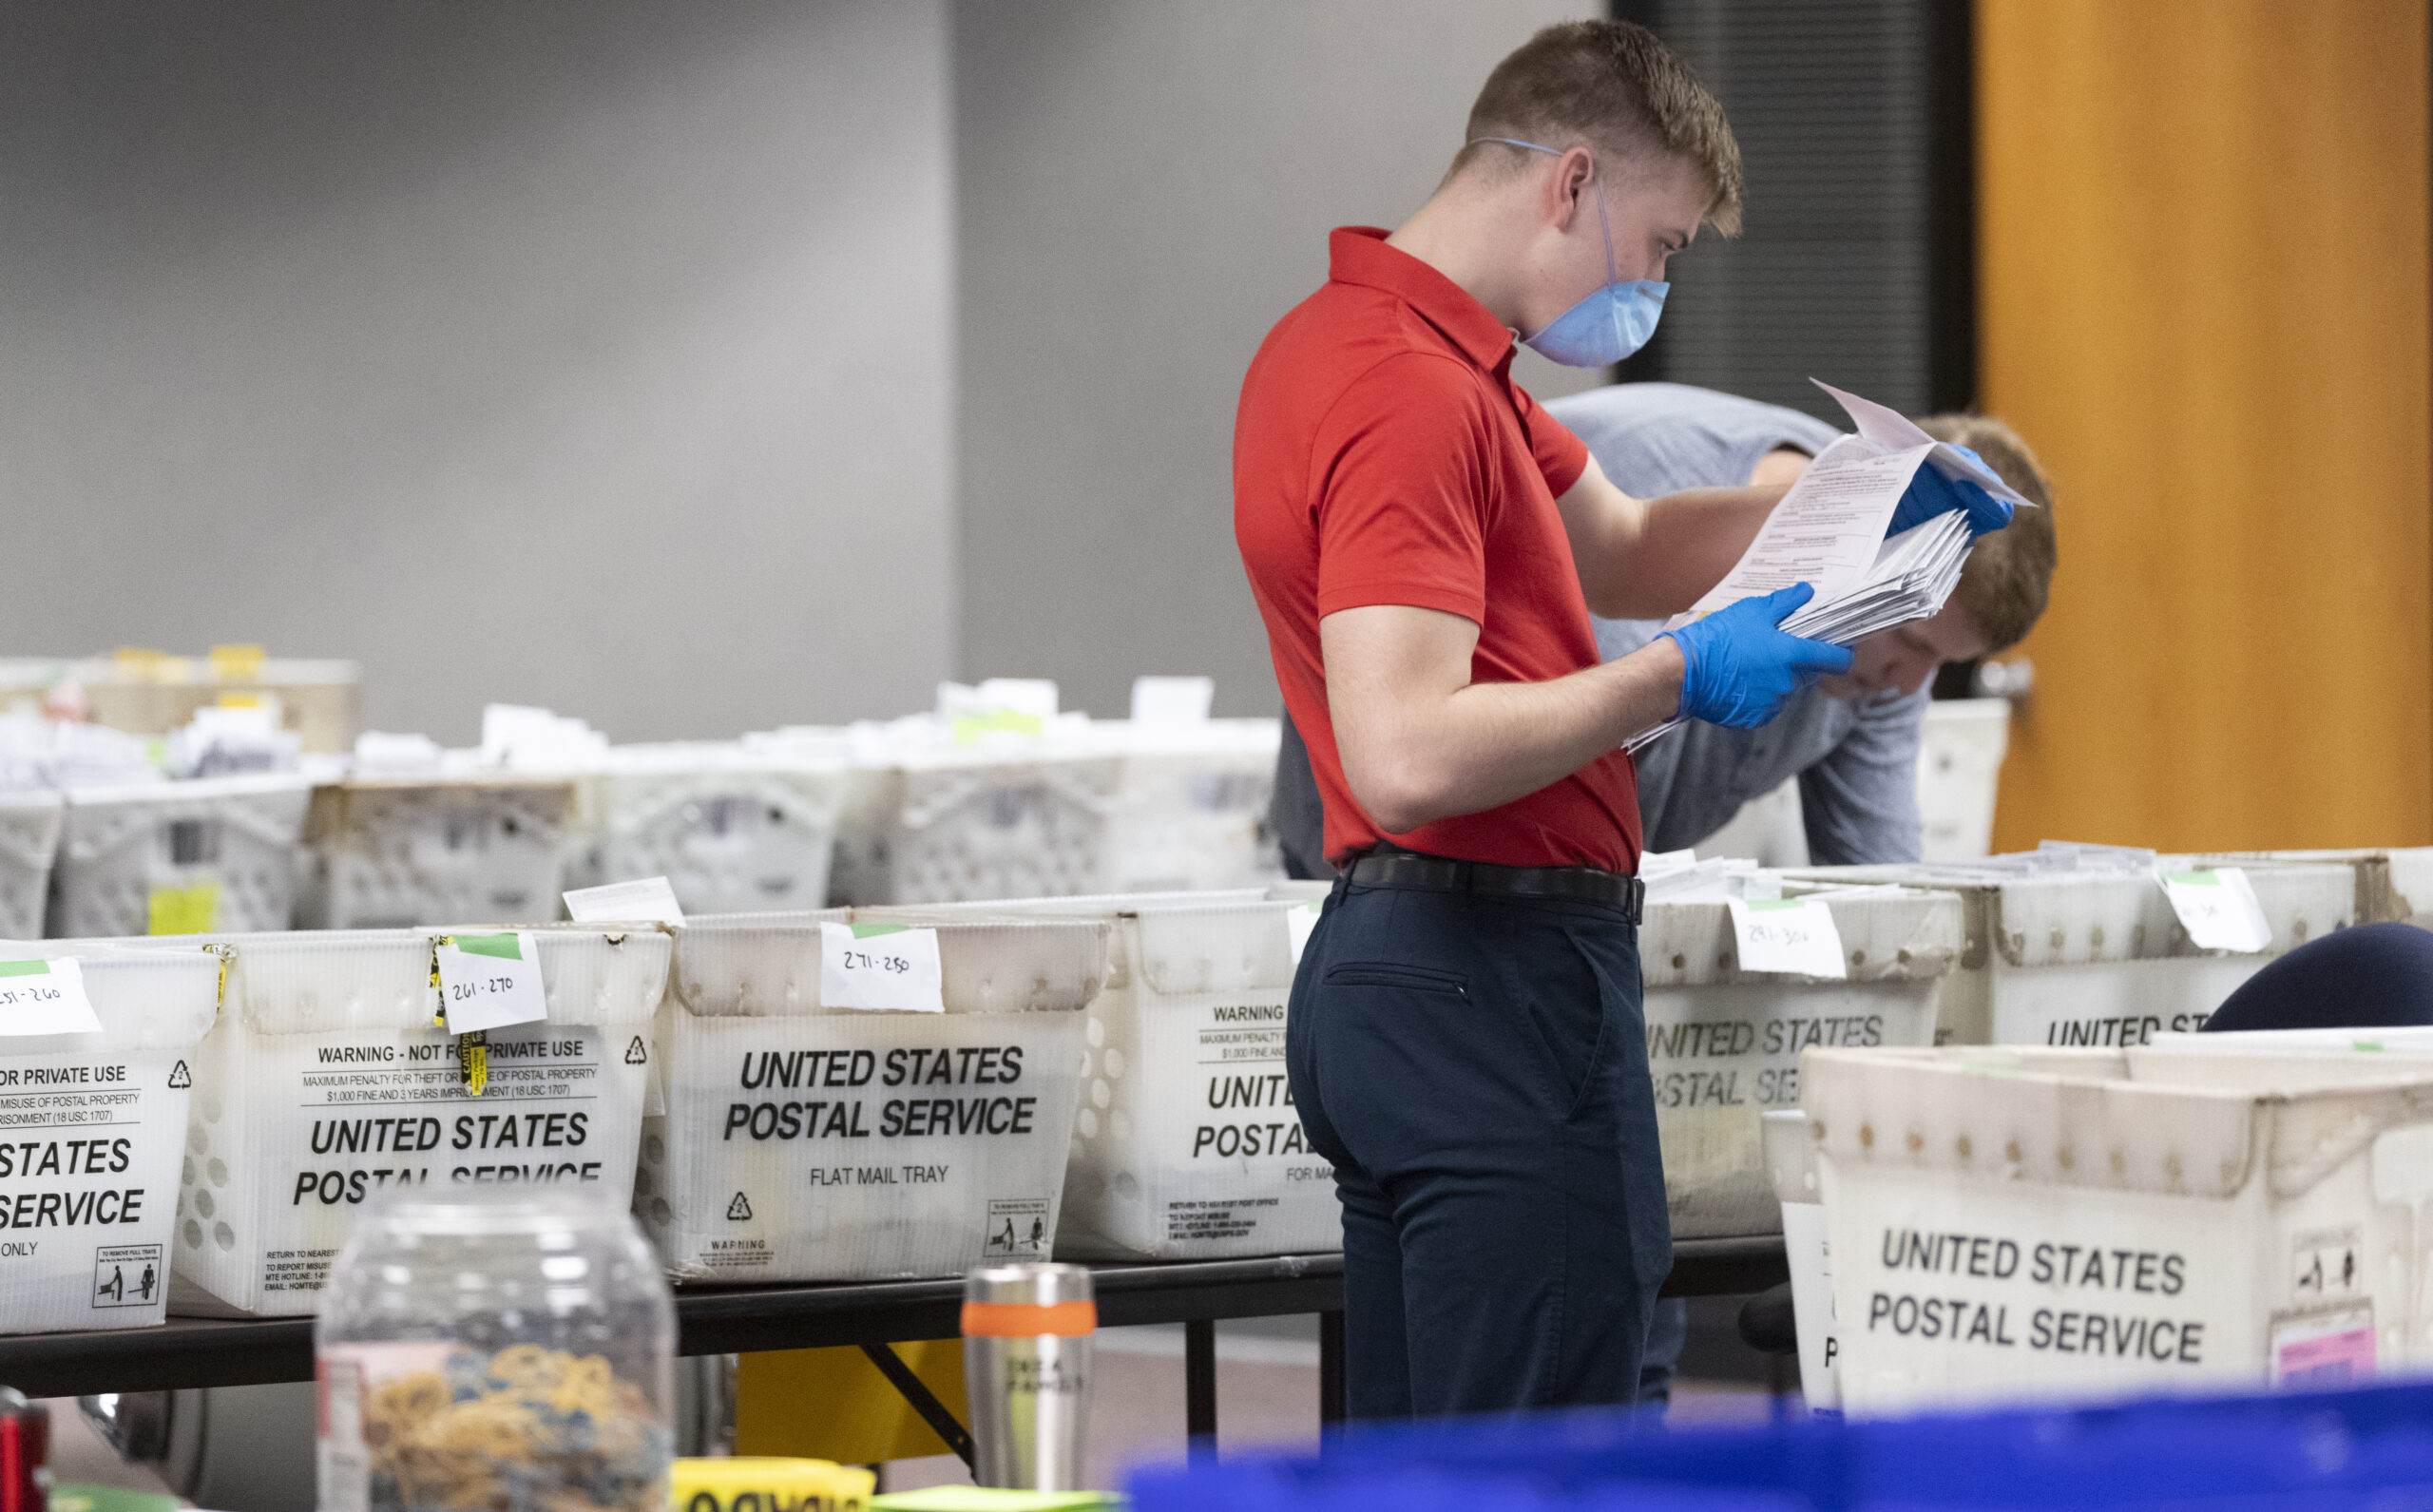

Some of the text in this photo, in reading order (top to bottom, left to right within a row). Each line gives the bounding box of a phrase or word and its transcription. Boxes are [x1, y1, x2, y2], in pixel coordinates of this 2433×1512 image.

[1214, 1005, 1284, 1022] WARNING
[1200, 1034, 1241, 1044] MAXIMUM
[1243, 1032, 1280, 1043] PENALTY
[1762, 1014, 1885, 1055] STATES
[317, 1045, 394, 1063] WARNING
[409, 1044, 441, 1061] NOT
[486, 1042, 547, 1059] PRIVATE
[552, 1041, 584, 1056] USE
[0, 1065, 126, 1086] OR PRIVATE USE
[303, 1076, 348, 1087] MAXIMUM
[350, 1075, 391, 1085] PENALTY
[393, 1074, 412, 1084] FOR
[414, 1072, 443, 1083] THEFT
[444, 1072, 458, 1083] OR
[497, 1070, 509, 1081] OF
[511, 1069, 546, 1081] POSTAL
[547, 1068, 597, 1080] PROPERTY
[739, 1046, 1024, 1089] UNITED STATES
[327, 1090, 355, 1102] $1,000
[356, 1090, 376, 1101] FINE
[379, 1089, 399, 1100] AND
[407, 1088, 439, 1100] YEARS
[527, 1084, 546, 1096] USC
[548, 1084, 571, 1096] 1707)
[1208, 1075, 1294, 1109] UNIT
[1652, 1070, 1745, 1108] STAL
[0, 1094, 141, 1109] MISUSE OF POSTAL PROPERTY
[53, 1112, 67, 1125] (18
[67, 1111, 87, 1122] USC
[90, 1110, 113, 1123] 1707)
[724, 1097, 1037, 1140] POSTAL SERVICE
[311, 1112, 589, 1154] UNITED STATES
[0, 1138, 131, 1178] STATES
[811, 1165, 948, 1186] FLAT MAIL TRAY
[1287, 1167, 1312, 1181] FOR
[0, 1189, 145, 1230] SERVICE
[1, 1241, 38, 1256] ONLY
[266, 1249, 339, 1259] RETURN TO NEAREST
[711, 1239, 766, 1250] WARNING
[277, 1263, 305, 1272] REPORT
[1882, 1229, 2186, 1295] UNITED STATES
[1868, 1292, 2206, 1364] POSTAL SERVICE
